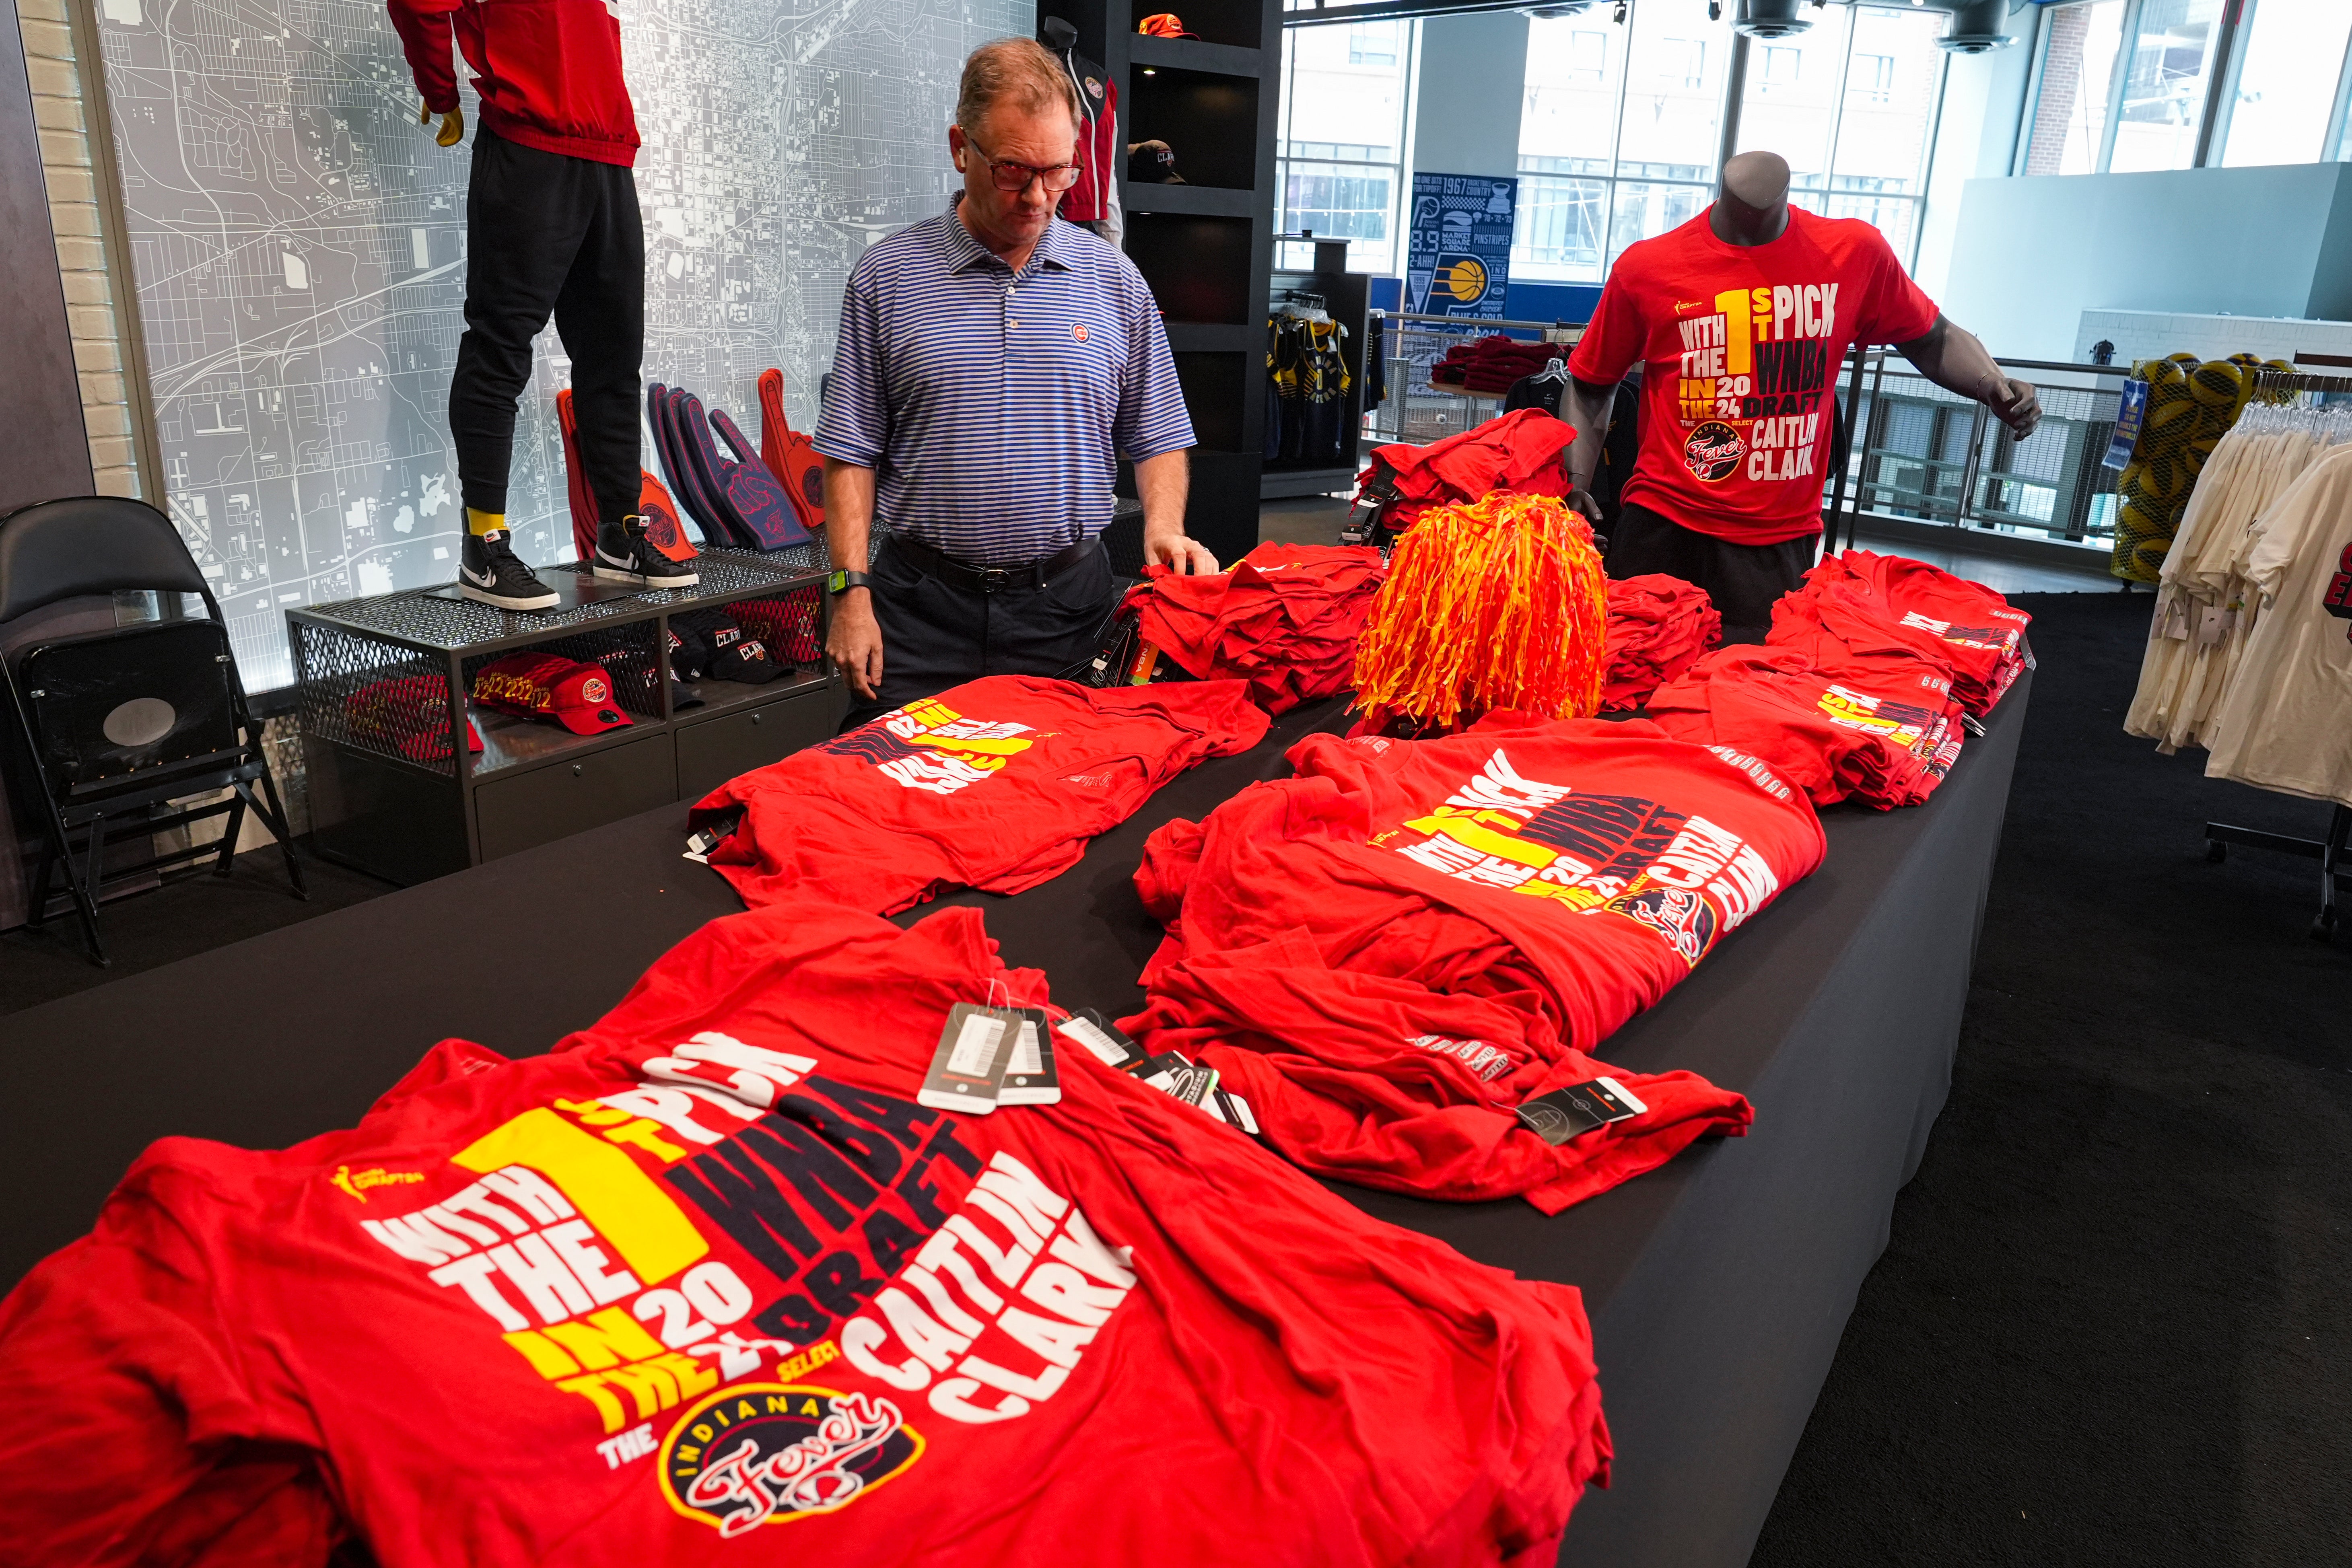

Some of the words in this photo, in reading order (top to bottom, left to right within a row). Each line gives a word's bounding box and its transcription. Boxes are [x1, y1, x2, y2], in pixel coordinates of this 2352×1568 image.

[1157, 152, 1175, 163] CLAR
[1414, 184, 1422, 192] FOR
[1443, 177, 1467, 195] 1967
[1467, 186, 1491, 196] COUNTRY
[1474, 234, 1510, 245] PINSTRIPES
[1409, 255, 1435, 268] 2-AHH!
[1774, 283, 1839, 340] PICK
[1679, 314, 1725, 350] WITH
[1681, 347, 1726, 377] THE
[1755, 340, 1827, 395] WNBA
[1679, 378, 1716, 399] IN
[1717, 376, 1751, 397] 20
[1680, 400, 1715, 419] THE
[1716, 399, 1740, 419] 24
[1742, 391, 1823, 418] DRAFT
[1693, 425, 1734, 440] INDIANA
[1752, 411, 1819, 449] CAITLIN
[1685, 436, 1747, 469] Fever
[1747, 444, 1813, 481] CLARK
[716, 630, 741, 647] CLAR
[739, 643, 766, 661] CLAR
[886, 715, 927, 738] 20
[911, 704, 962, 728] IN
[1376, 741, 1387, 750] 3XL
[1445, 748, 1571, 819] PICK
[1517, 792, 1654, 863] WNBA
[1597, 805, 1688, 880] DRAFT
[1395, 833, 1487, 874] WITH
[1646, 815, 1744, 888] CAITLIN
[1448, 856, 1538, 889] THE
[1512, 879, 1569, 897] IN
[1539, 856, 1593, 885] 20
[1578, 875, 1628, 899] 24
[1626, 874, 1651, 892] SELECT
[1707, 844, 1779, 932] CLARK
[1545, 887, 1606, 912] THE
[1632, 886, 1703, 951] Fever
[596, 1031, 818, 1146] PICK
[662, 1073, 943, 1281] WNBA
[361, 1163, 576, 1268] WITH
[429, 1220, 642, 1332] THE
[555, 1343, 719, 1435] THE
[751, 1117, 989, 1346] DRAFT
[840, 1151, 1069, 1391] CAITLIN
[502, 1305, 667, 1378] IN
[632, 1262, 753, 1350] 20
[928, 1206, 1139, 1424] CLARK
[597, 1422, 659, 1471] THE
[775, 1340, 840, 1383] SELECT
[675, 1396, 820, 1477] INDIANA
[686, 1392, 903, 1539] Fever
